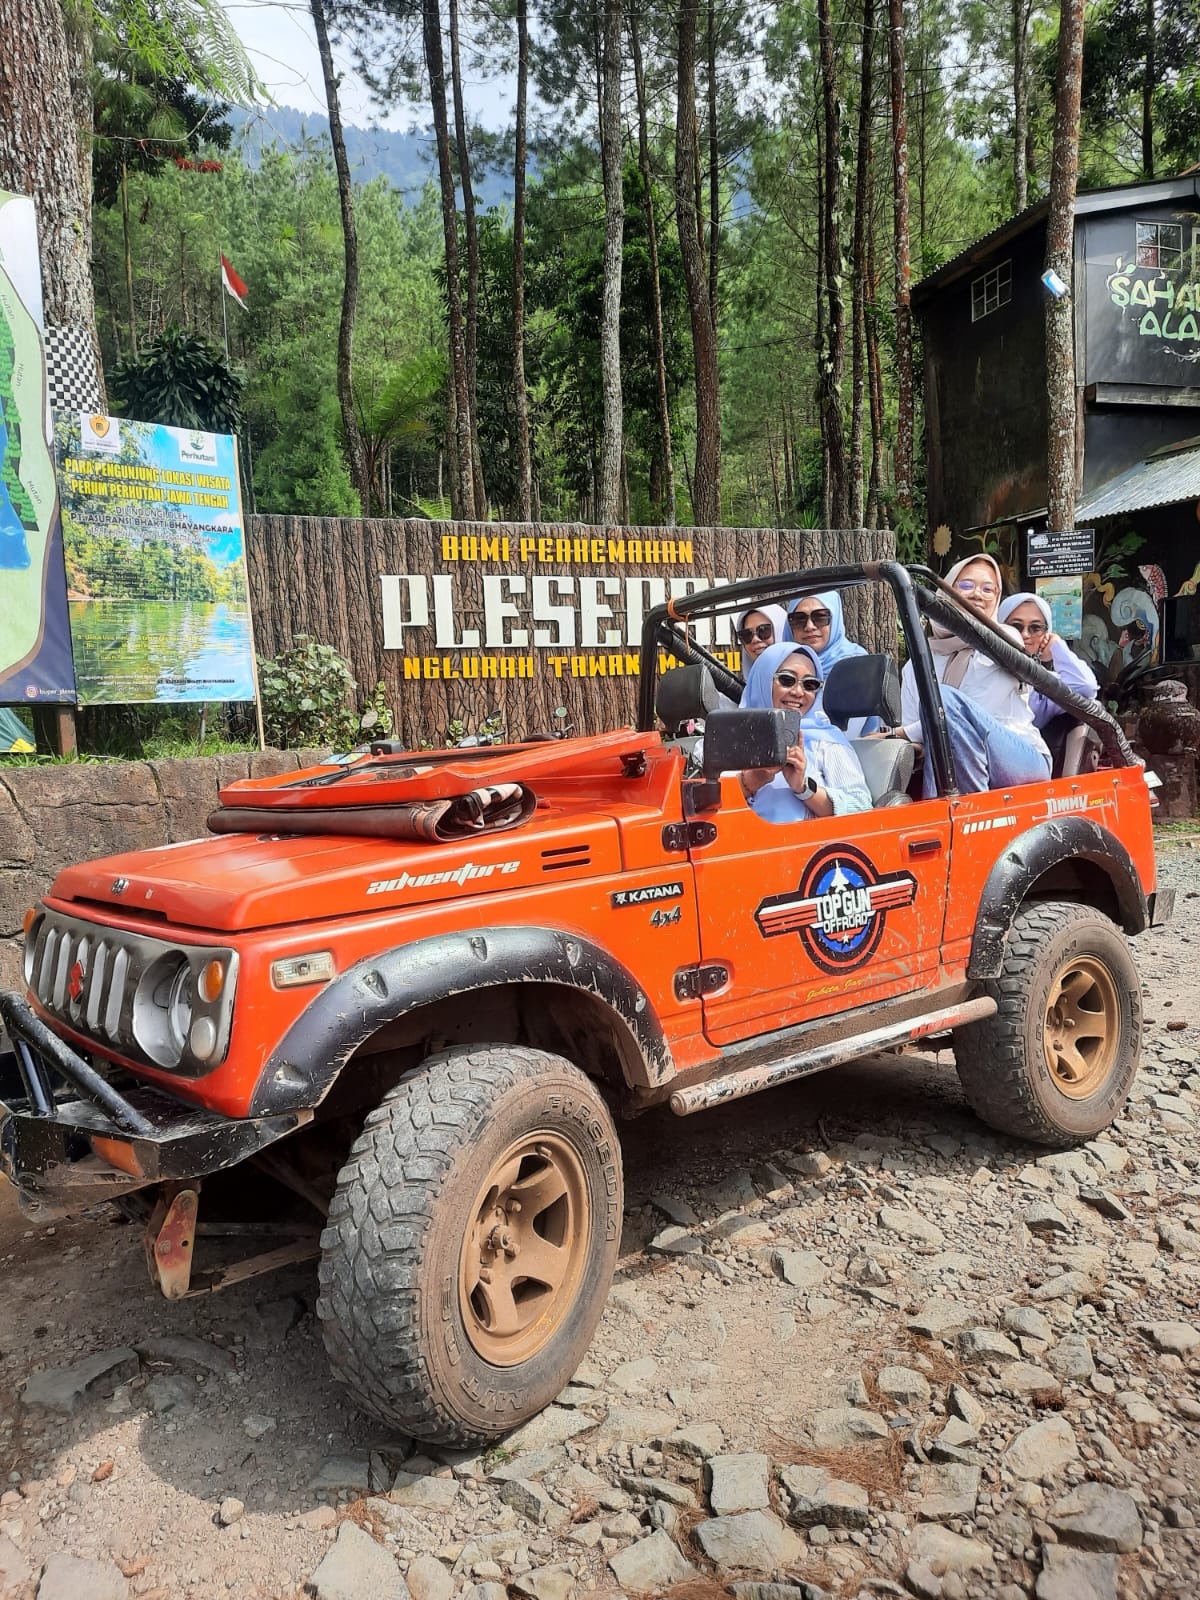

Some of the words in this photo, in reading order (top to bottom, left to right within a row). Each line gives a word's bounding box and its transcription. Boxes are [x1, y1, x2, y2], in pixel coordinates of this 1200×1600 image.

[1111, 276, 1200, 312] SAHA
[16, 362, 24, 388] Hutan
[181, 450, 216, 462] Perhutani
[64, 457, 92, 474] PARA
[94, 461, 160, 483] PENGUNJUNG
[161, 469, 195, 487] LOKASI
[196, 473, 231, 491] WISATA
[28, 480, 42, 504] Hutan
[71, 479, 108, 496] PERUM
[109, 482, 165, 502] PERHUTANI
[166, 489, 192, 505] JAWA
[193, 492, 229, 509] TENGAH
[88, 513, 132, 525] ASURANSI
[134, 518, 167, 529] BHAKTI
[169, 522, 234, 534] BHAYANGKARA
[442, 535, 510, 562] BUMI
[520, 537, 694, 564] PERKEMAHAN
[403, 656, 534, 680] NGLURAH
[366, 860, 521, 895] adventure
[629, 885, 682, 902] KATANA
[816, 892, 842, 922] TOP
[842, 887, 872, 916] GUN
[650, 905, 682, 928] 4x4
[823, 913, 868, 934] OFFROAD
